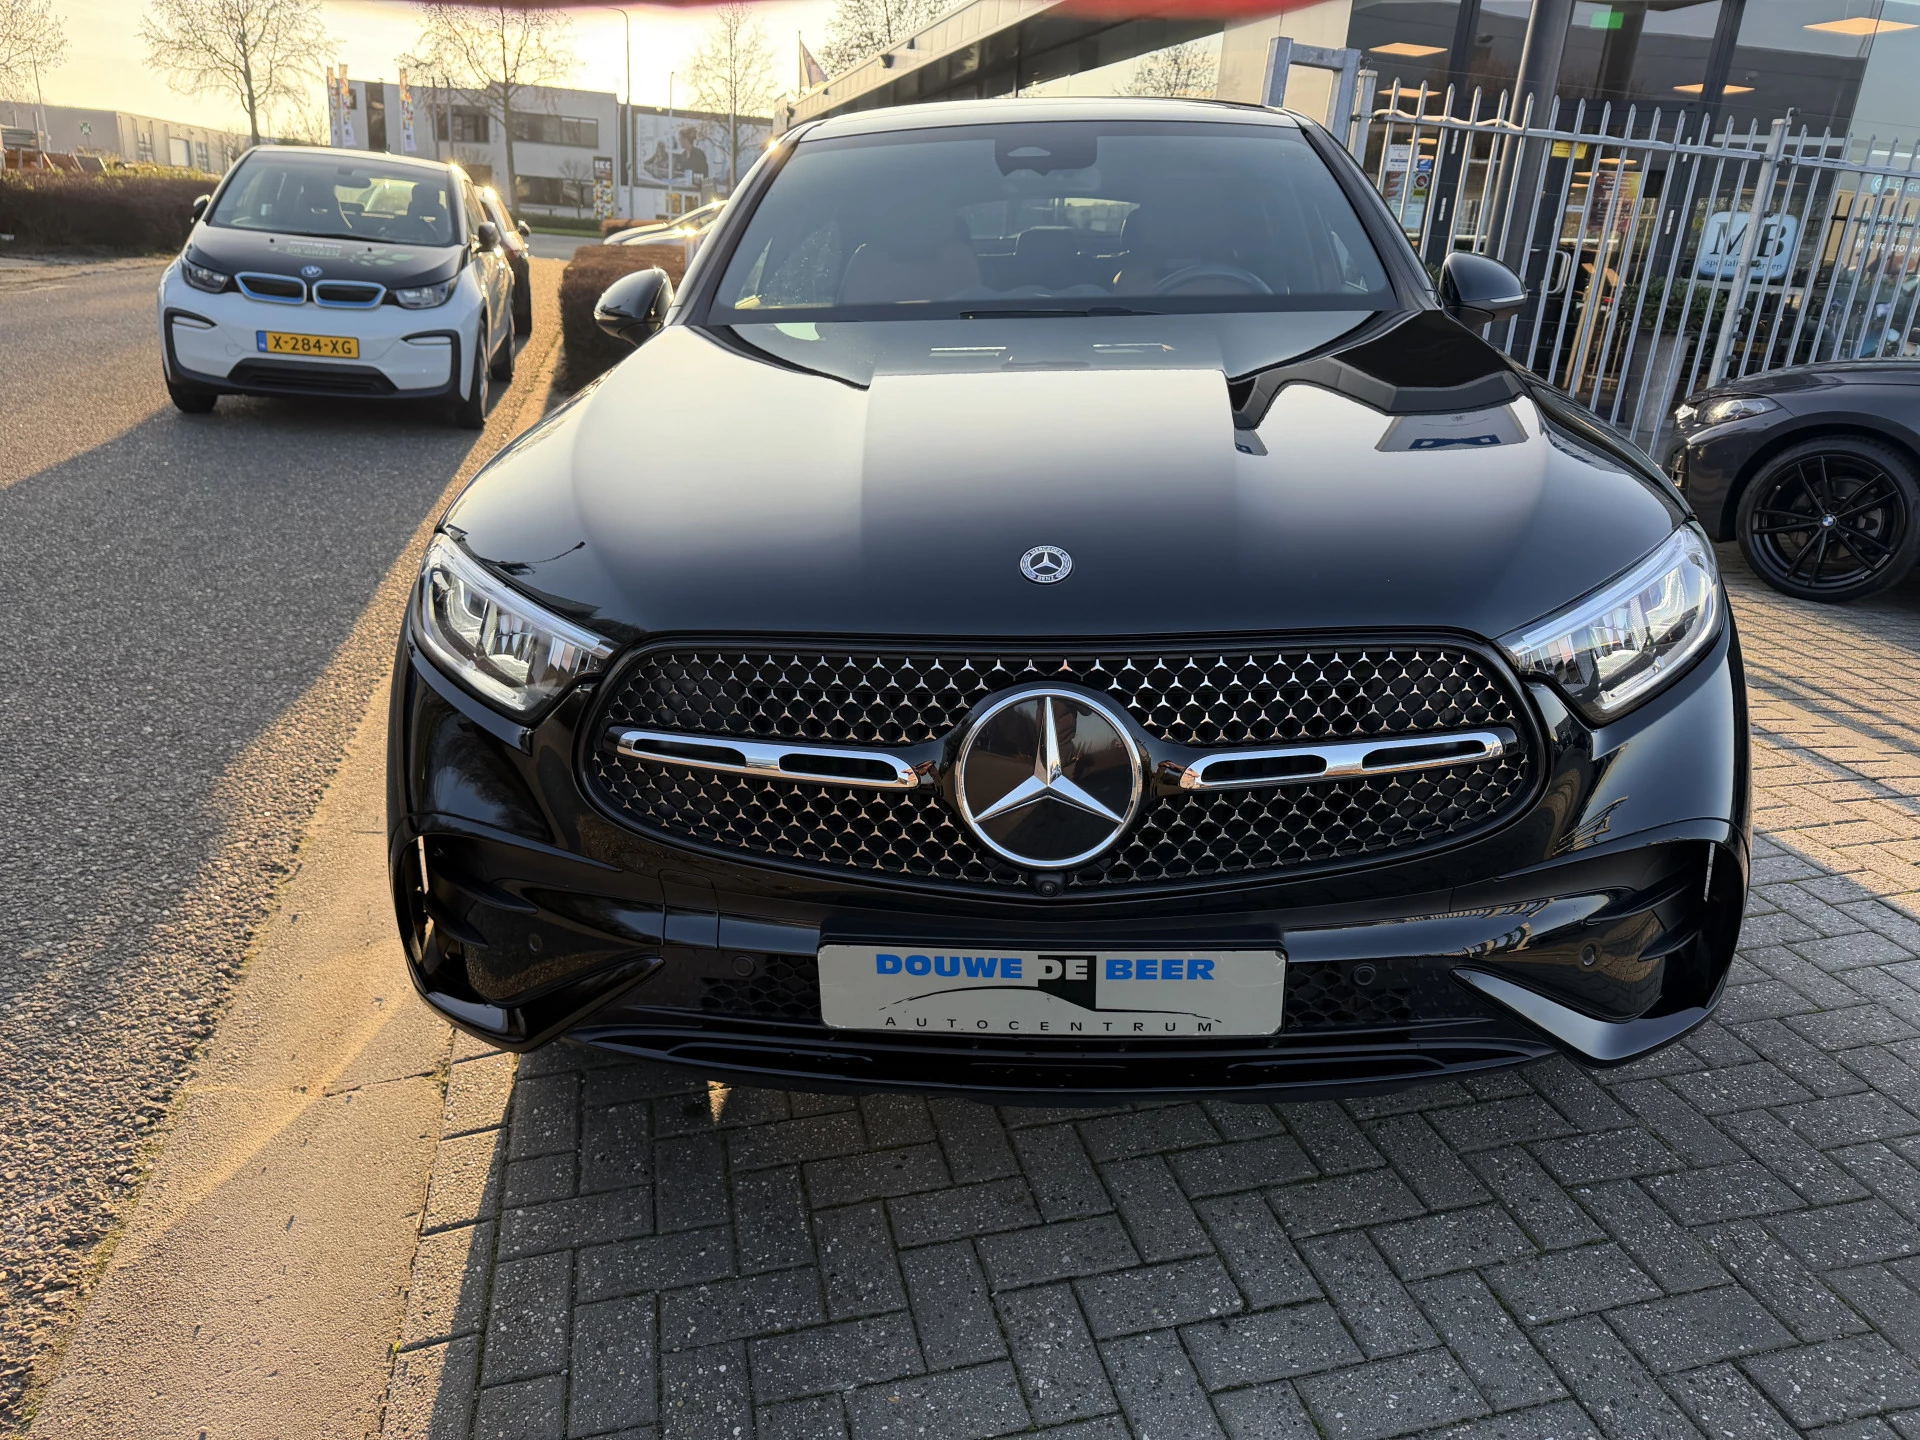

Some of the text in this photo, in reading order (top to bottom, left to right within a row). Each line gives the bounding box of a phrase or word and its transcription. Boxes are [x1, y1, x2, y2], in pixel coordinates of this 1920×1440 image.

[1877, 213, 1915, 225] speiali
[1709, 221, 1787, 258] MB
[1855, 238, 1875, 250] Mt
[272, 335, 353, 355] X-284-XG
[876, 954, 1215, 981] DOUWE DE BEER
[885, 1016, 1212, 1032] AUTOCENTRUM
